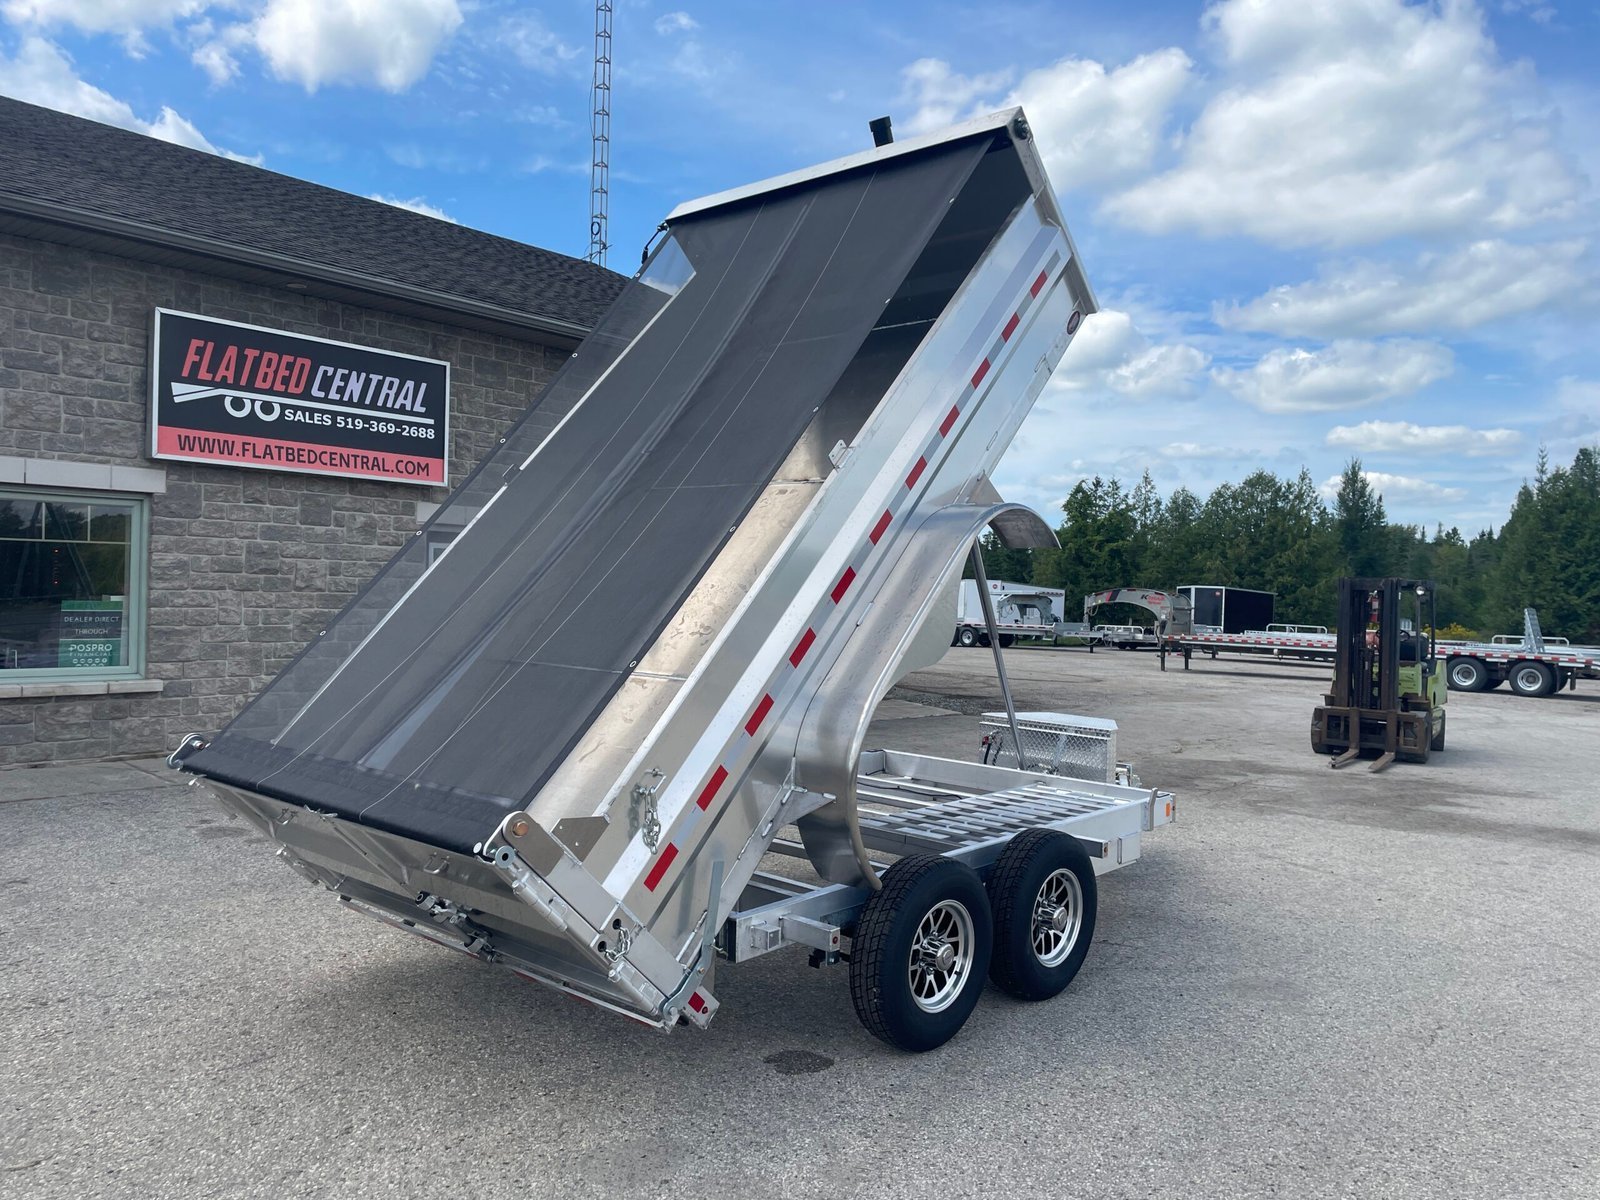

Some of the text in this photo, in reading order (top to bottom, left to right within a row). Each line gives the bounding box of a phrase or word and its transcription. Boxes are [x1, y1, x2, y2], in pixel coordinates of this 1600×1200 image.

[181, 338, 427, 413] FLATBED CENTRAL
[284, 409, 435, 439] SALES 519-369-2688
[177, 434, 430, 477] WWW.FLATBEDCENTRAL.COM
[67, 643, 113, 652] POSPRO
